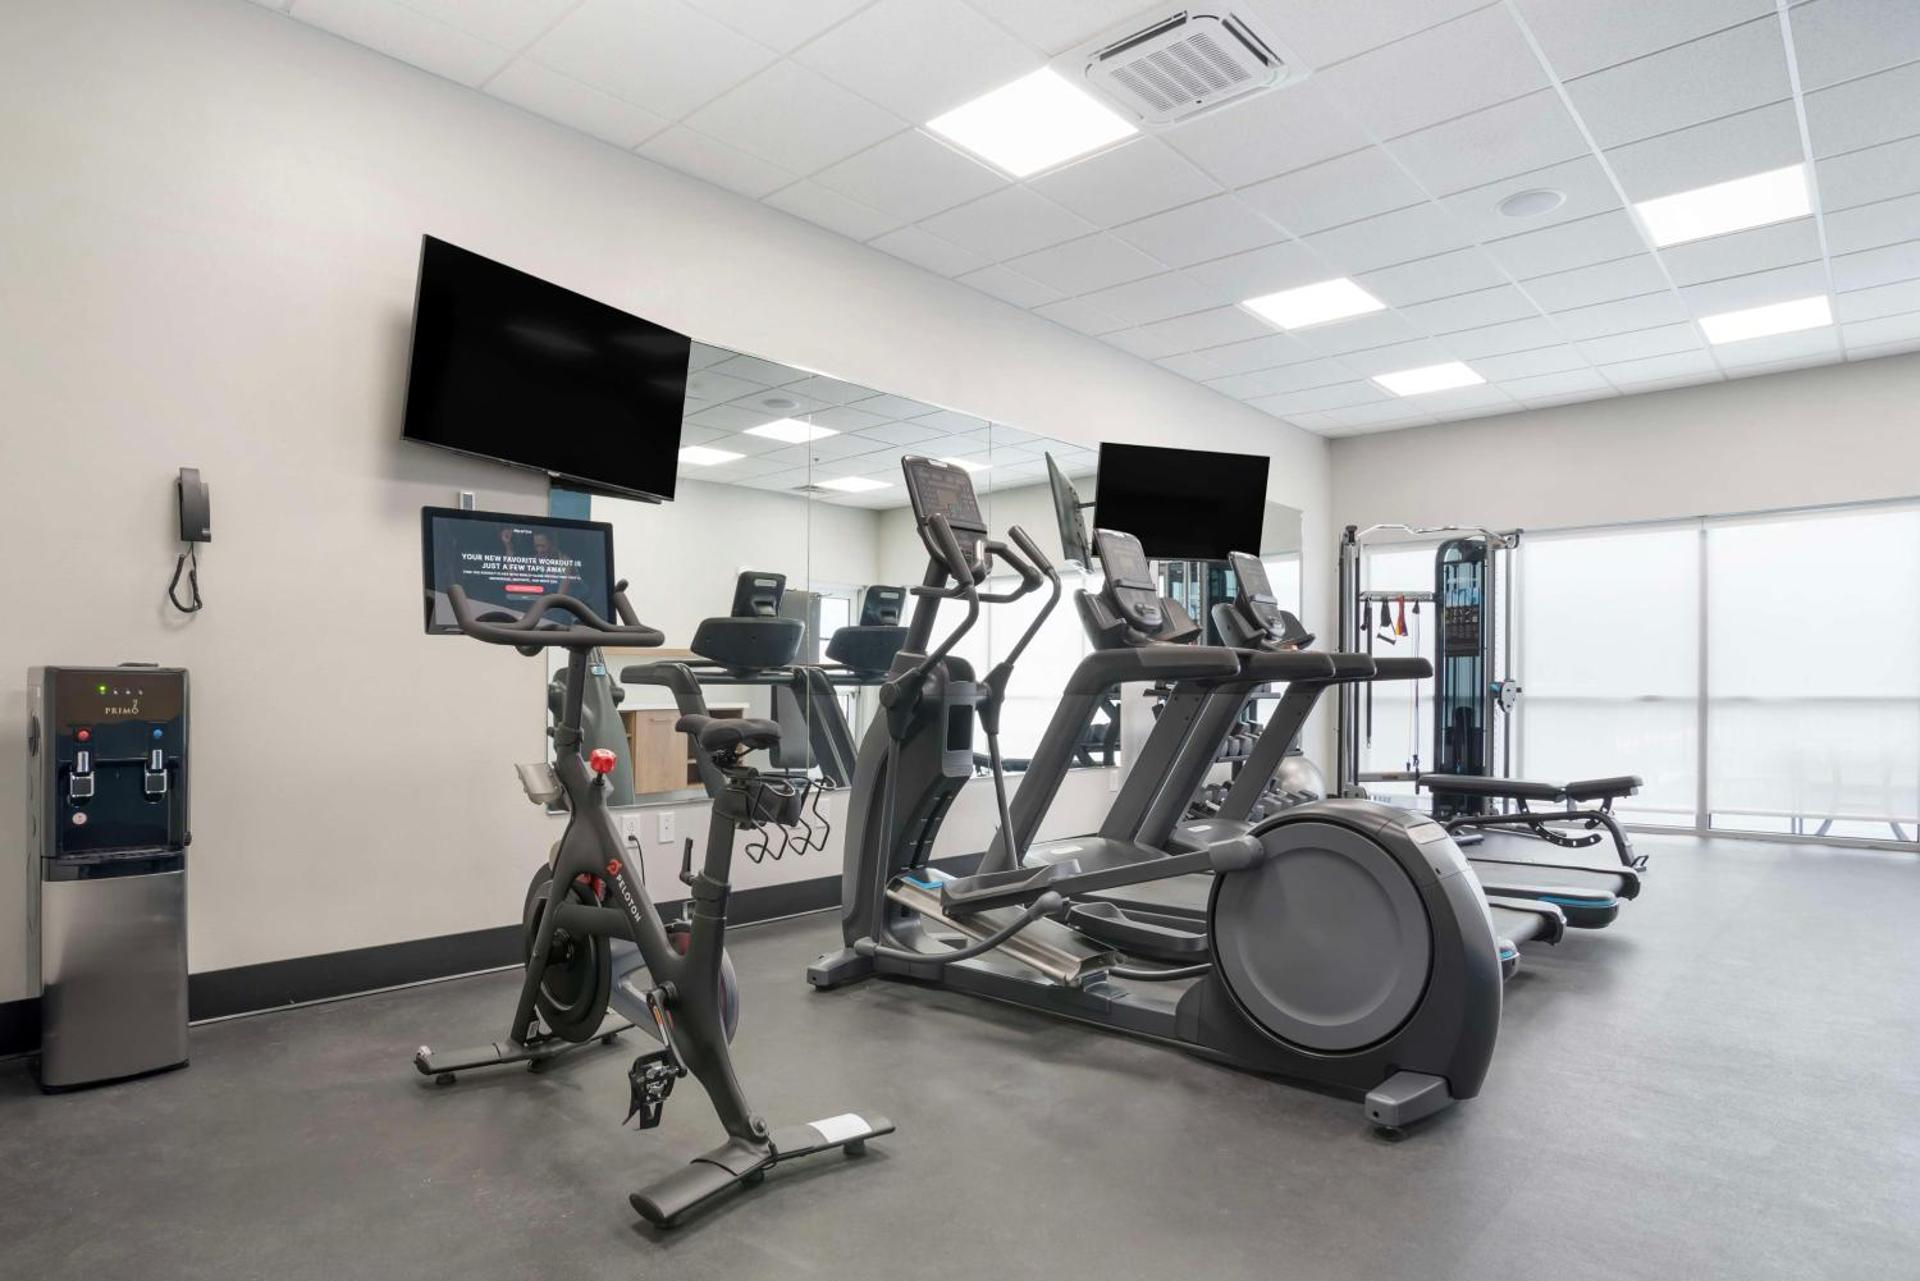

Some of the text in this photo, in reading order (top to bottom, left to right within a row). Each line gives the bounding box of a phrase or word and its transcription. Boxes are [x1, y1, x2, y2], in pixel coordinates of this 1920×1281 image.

[481, 562, 501, 570] JUST
[484, 554, 501, 562] NEW
[502, 556, 537, 564] FAVORITE
[538, 558, 573, 567] WORKOUT
[105, 705, 139, 715] PRIMO
[616, 873, 641, 922] PELOTON
